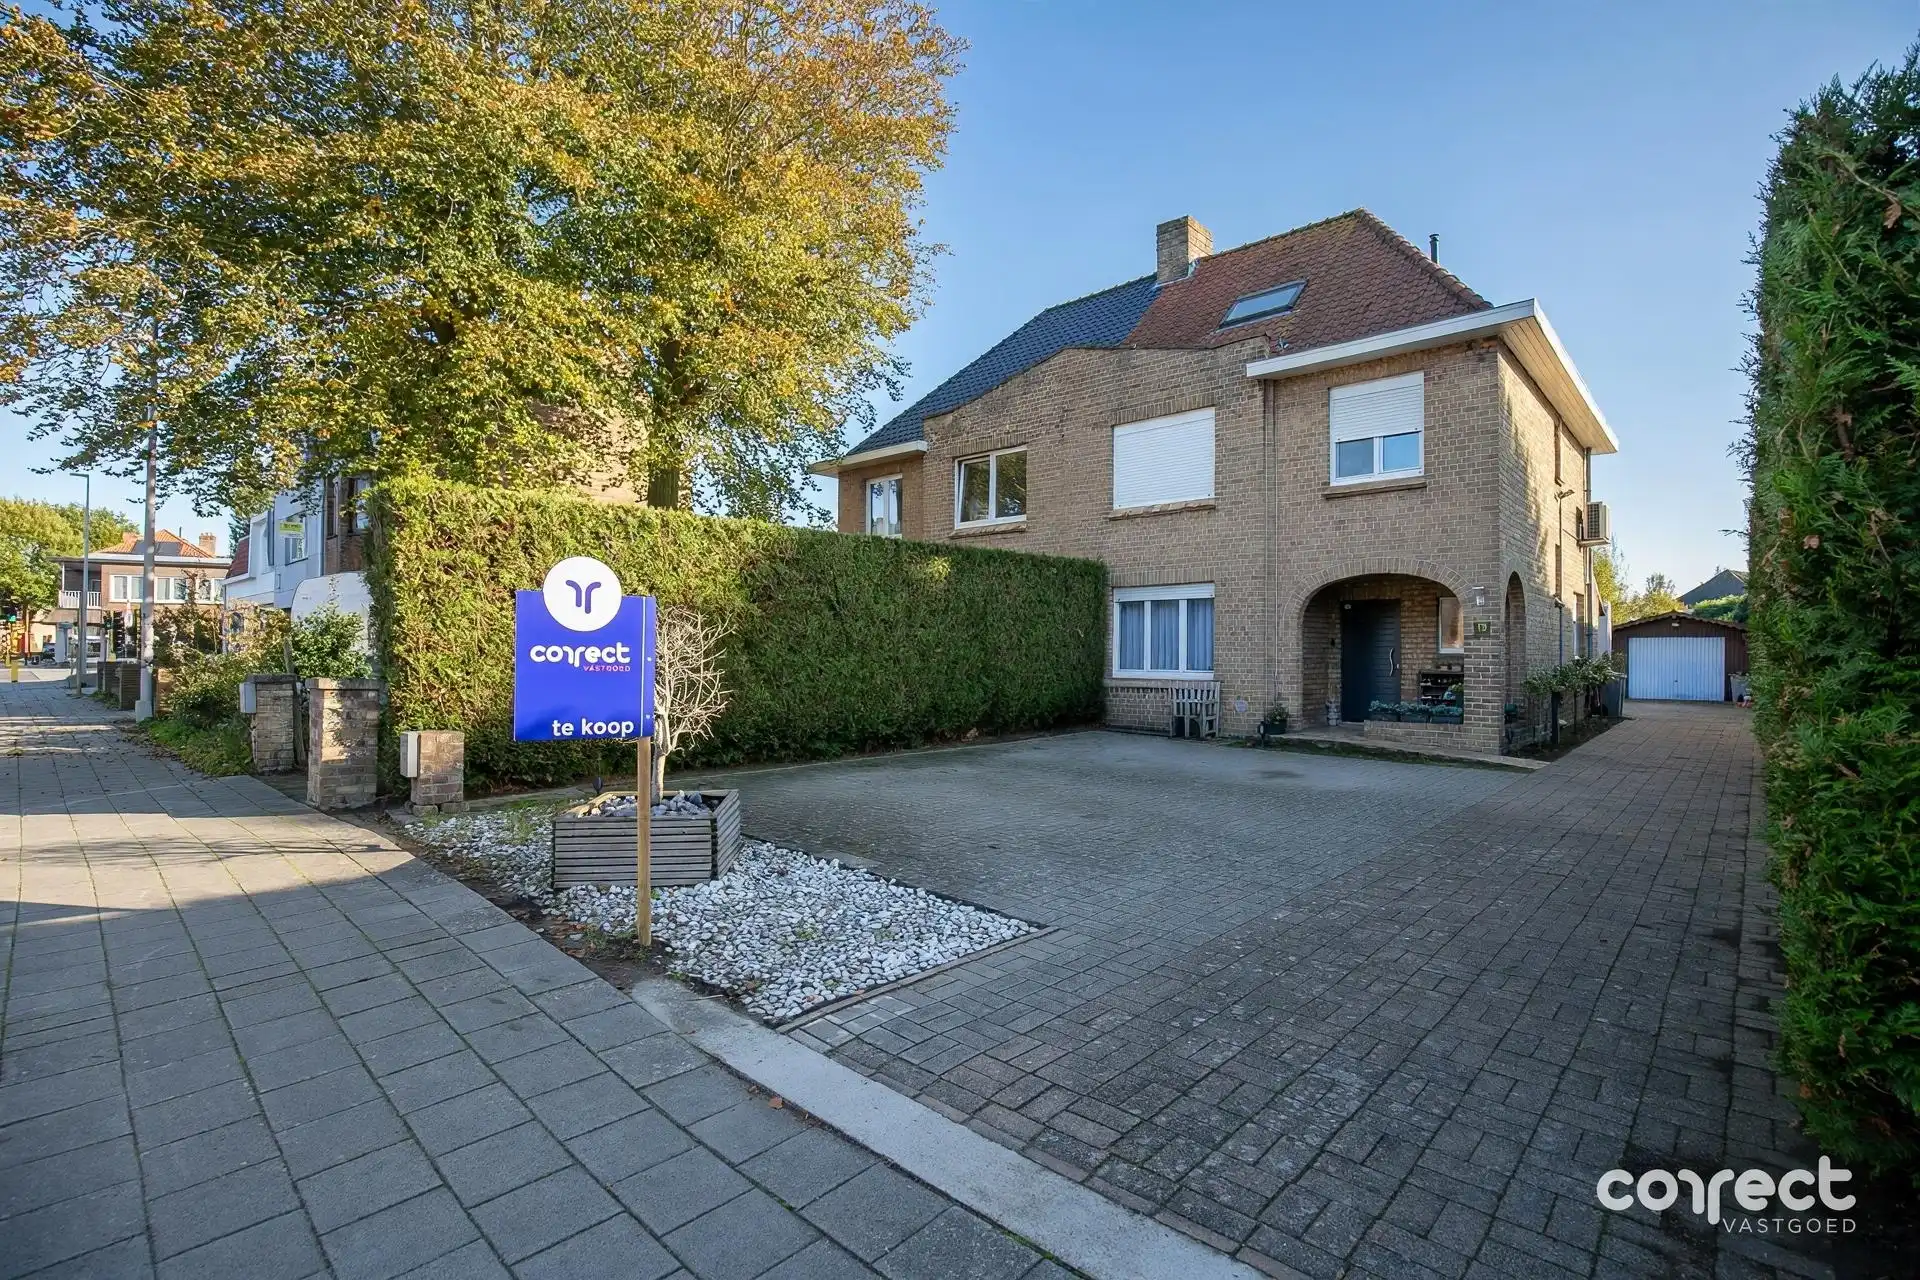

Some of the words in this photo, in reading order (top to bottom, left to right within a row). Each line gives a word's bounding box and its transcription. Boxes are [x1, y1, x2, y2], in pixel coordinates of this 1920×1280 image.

[530, 642, 631, 667] correct
[583, 664, 631, 672] VASTGOED
[552, 720, 574, 736] te
[581, 718, 634, 738] koop
